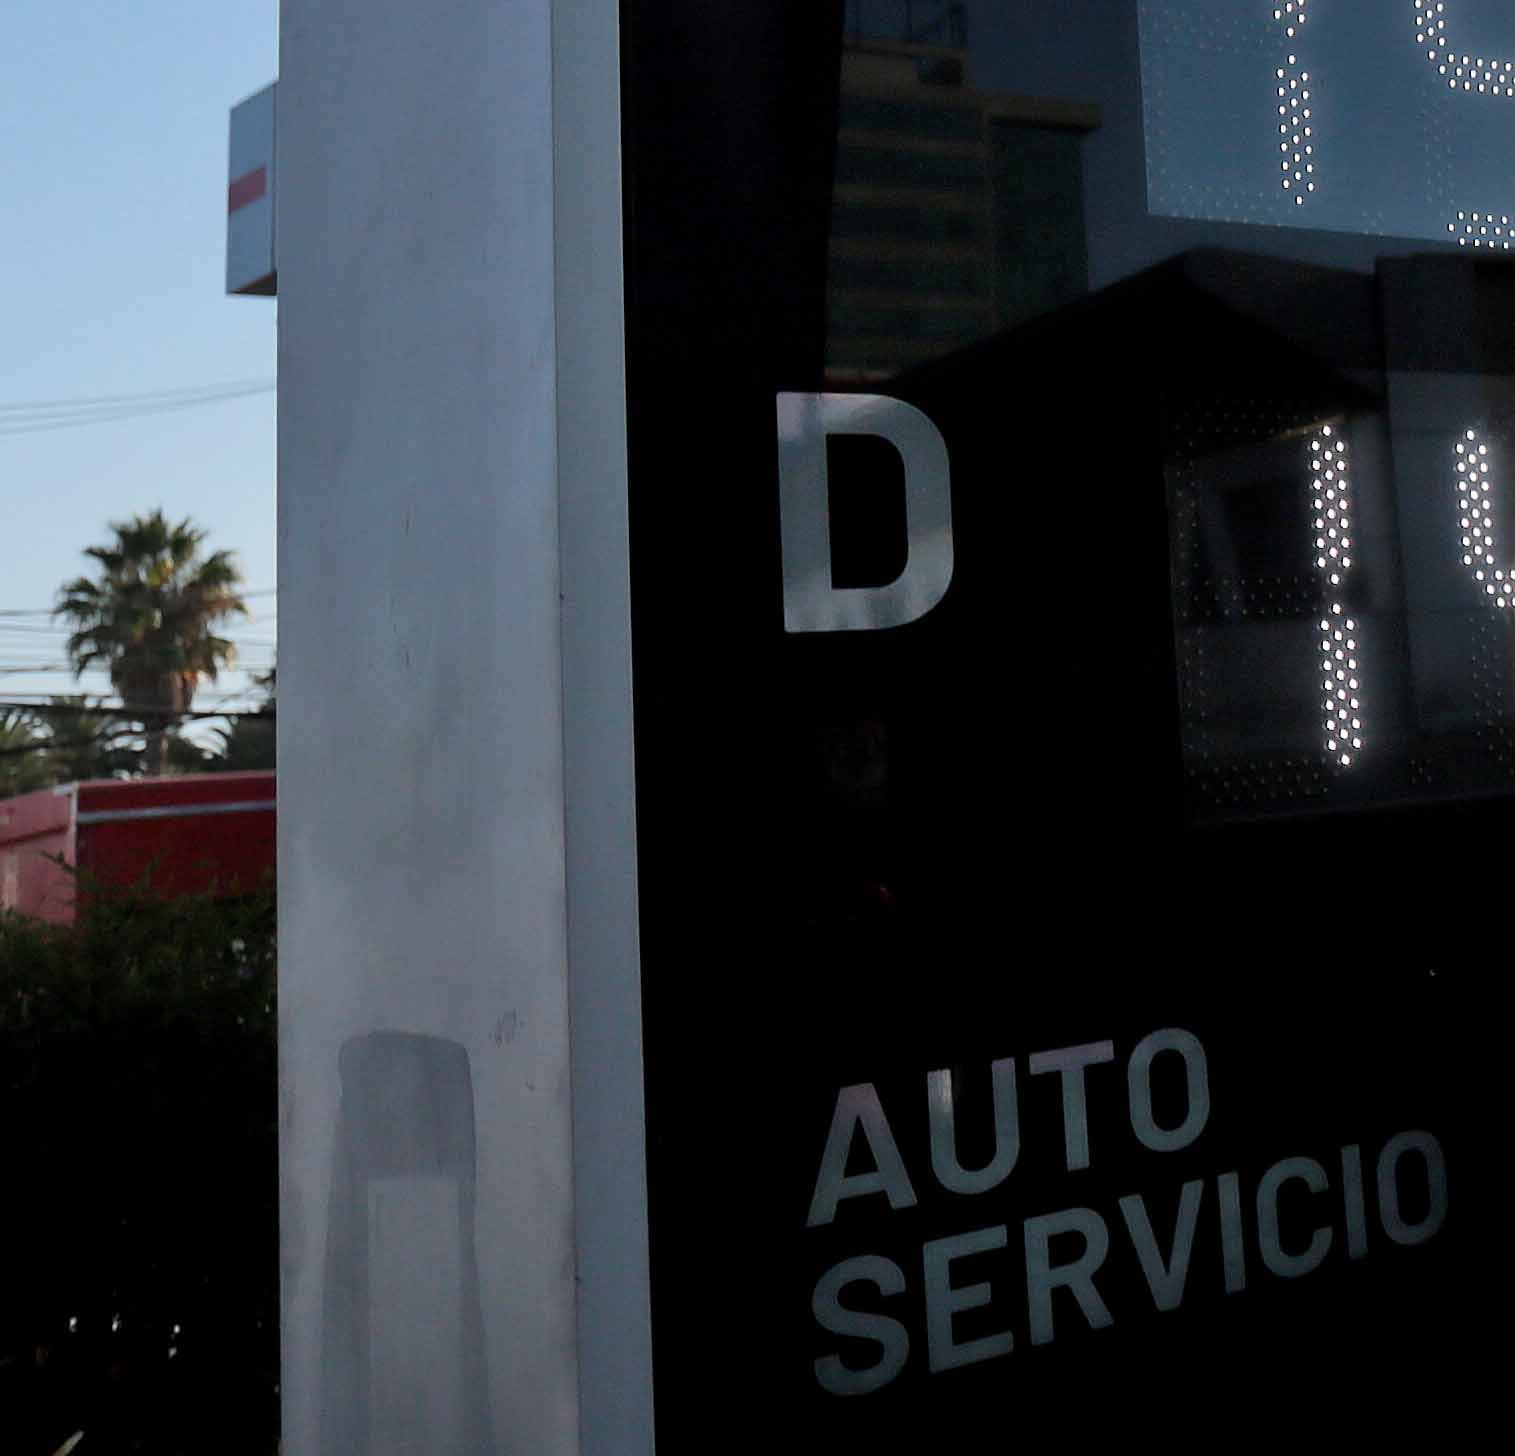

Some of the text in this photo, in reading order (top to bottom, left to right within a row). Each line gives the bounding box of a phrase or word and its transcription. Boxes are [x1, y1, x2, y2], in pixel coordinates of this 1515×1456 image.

[776, 390, 955, 634] D
[806, 1027, 1211, 1228] AUTO
[811, 1129, 1449, 1397] SERVICIO
